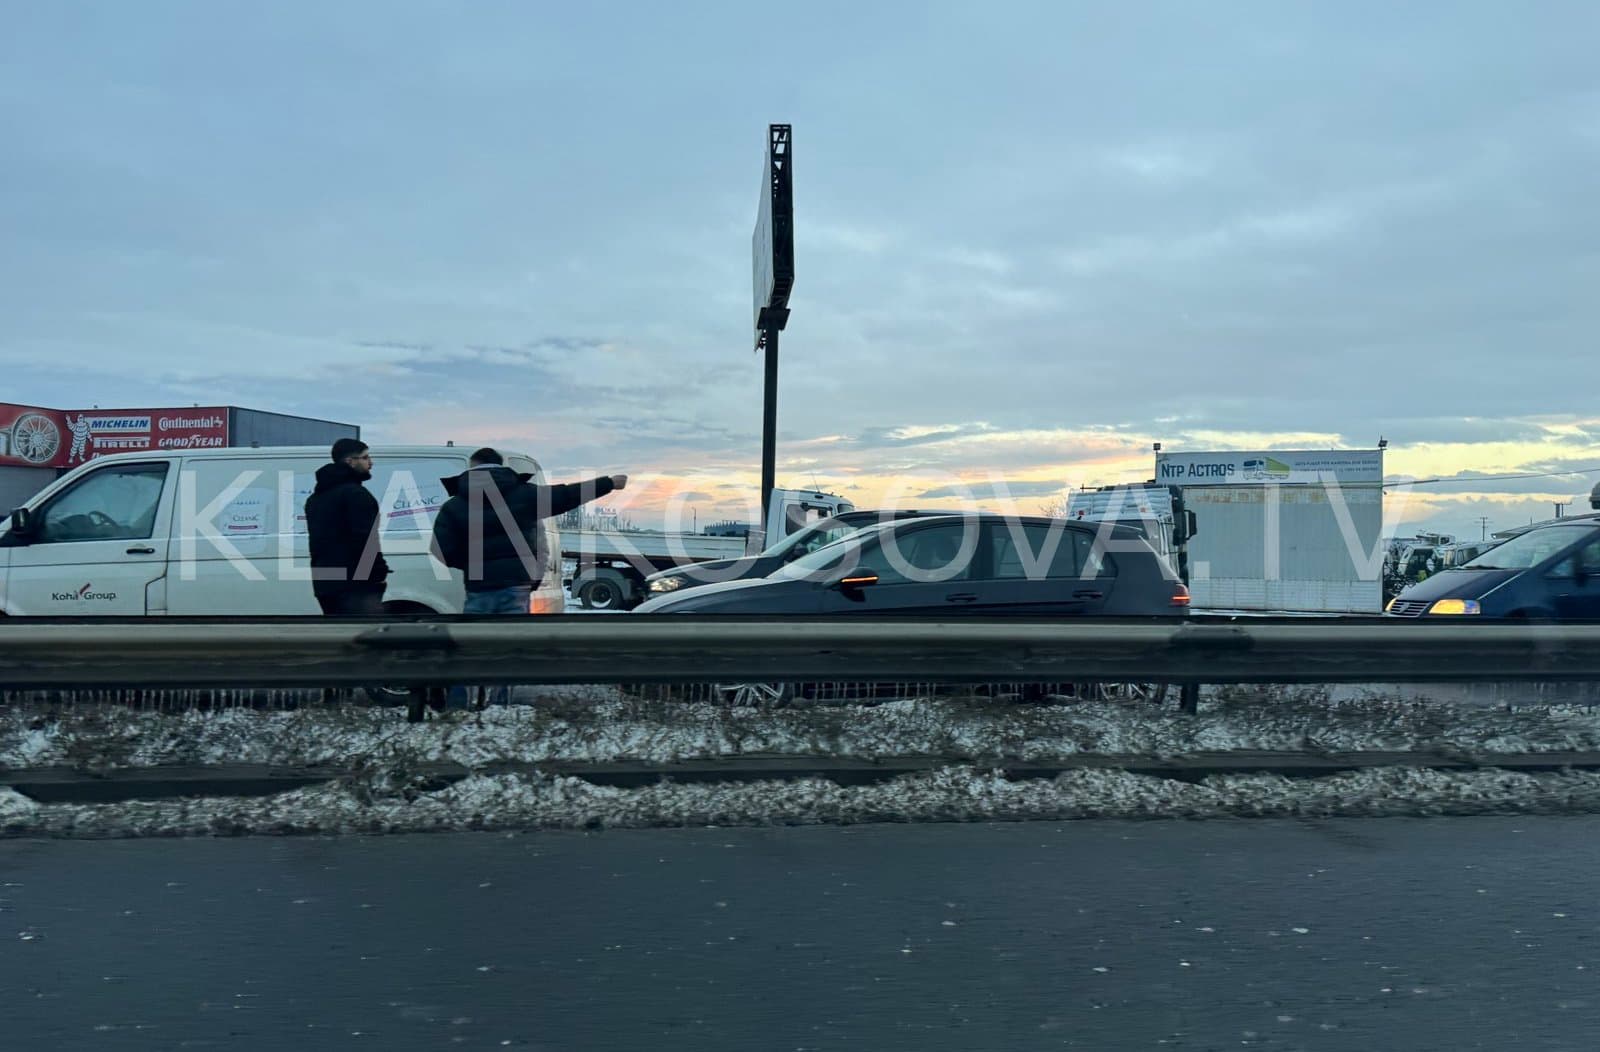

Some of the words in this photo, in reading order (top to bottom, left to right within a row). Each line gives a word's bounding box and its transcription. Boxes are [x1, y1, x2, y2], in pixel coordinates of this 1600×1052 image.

[91, 419, 148, 429] MICHELIN
[158, 416, 215, 431] Continental
[93, 437, 150, 448] PIRELLI
[158, 434, 222, 448] GOODYEAR
[84, 591, 117, 602] Group
